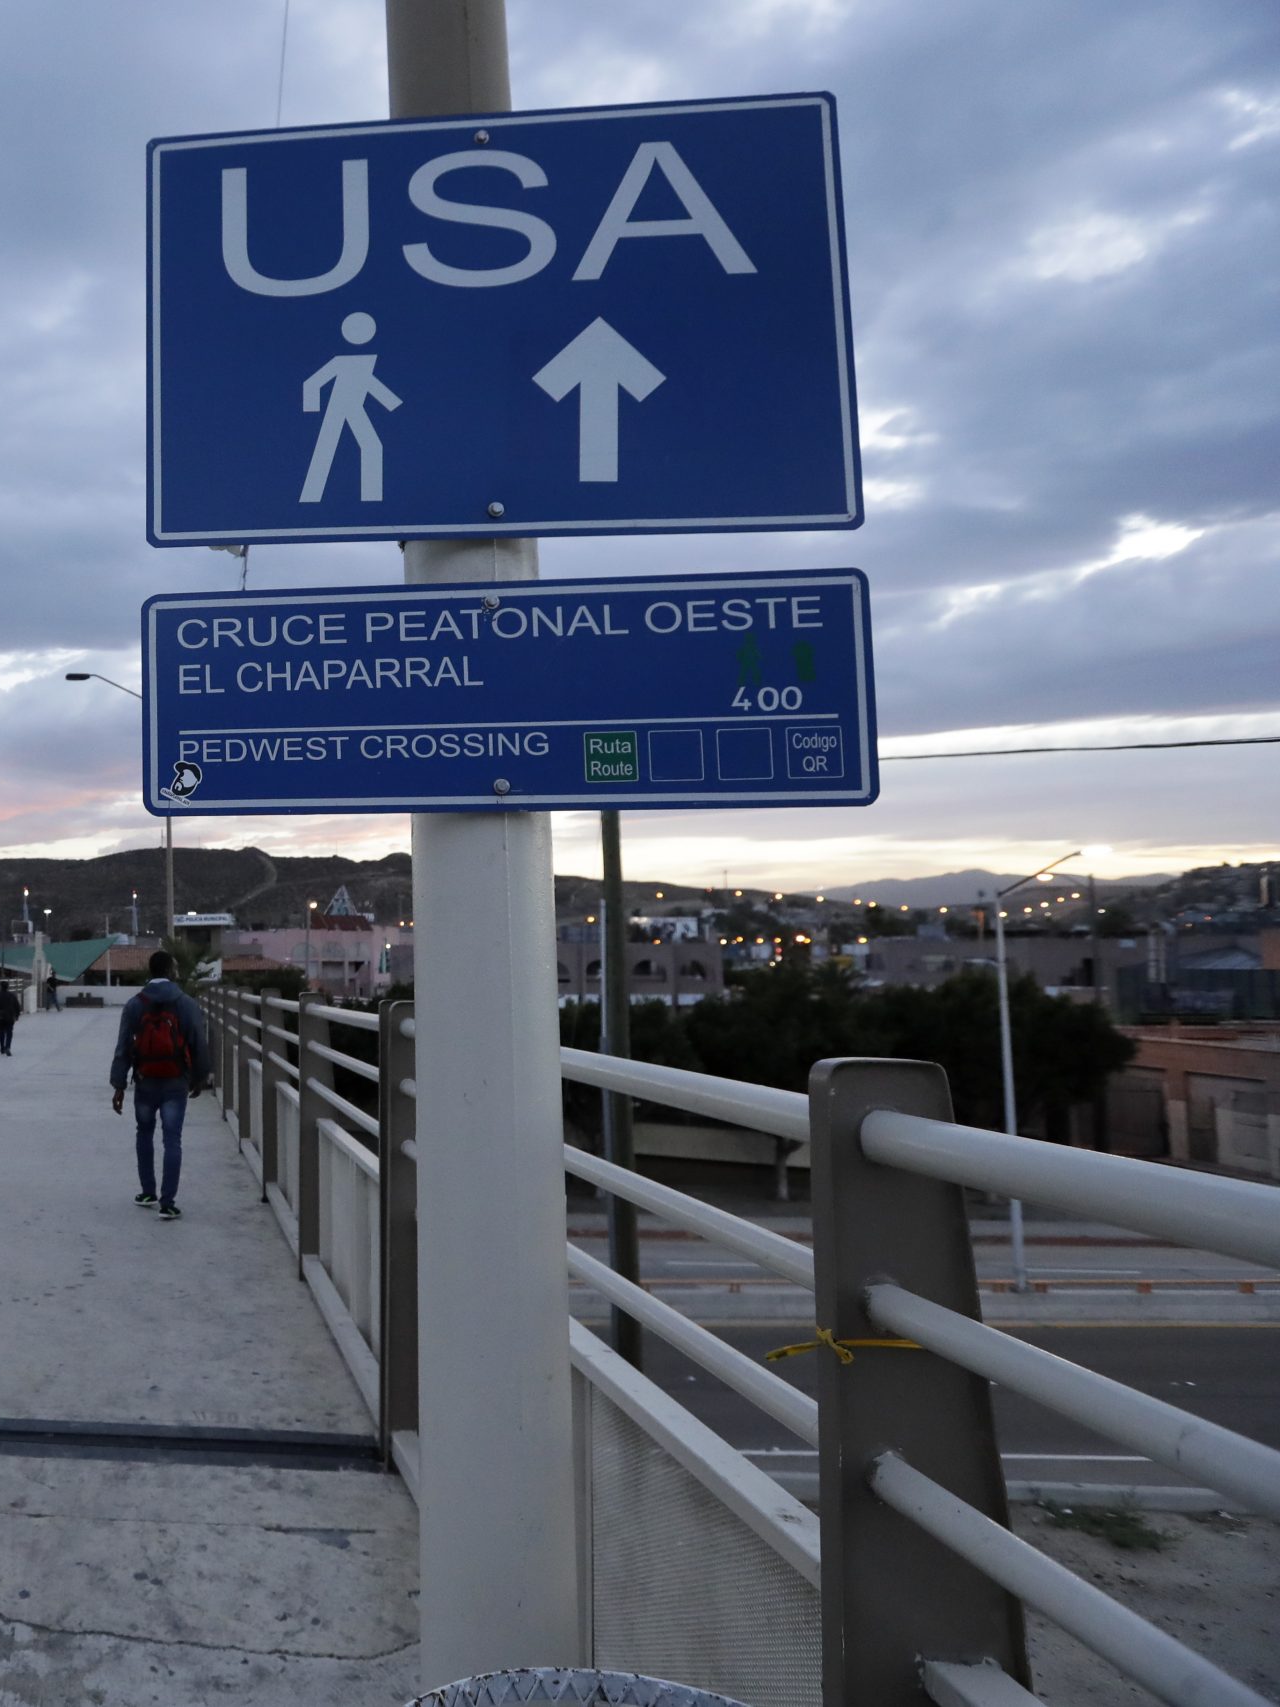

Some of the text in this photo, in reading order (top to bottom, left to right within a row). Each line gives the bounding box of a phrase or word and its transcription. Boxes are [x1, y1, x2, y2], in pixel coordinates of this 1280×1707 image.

[222, 141, 758, 297] USA
[177, 596, 824, 649] CRUCE PEATONAL OESTE
[179, 656, 484, 694] EL CHAPARRAL
[730, 686, 803, 712] 400
[179, 733, 550, 762] PEDWEST CROSSING
[589, 738, 632, 755] Ruta
[590, 761, 634, 777] Route
[803, 756, 829, 773] QR
